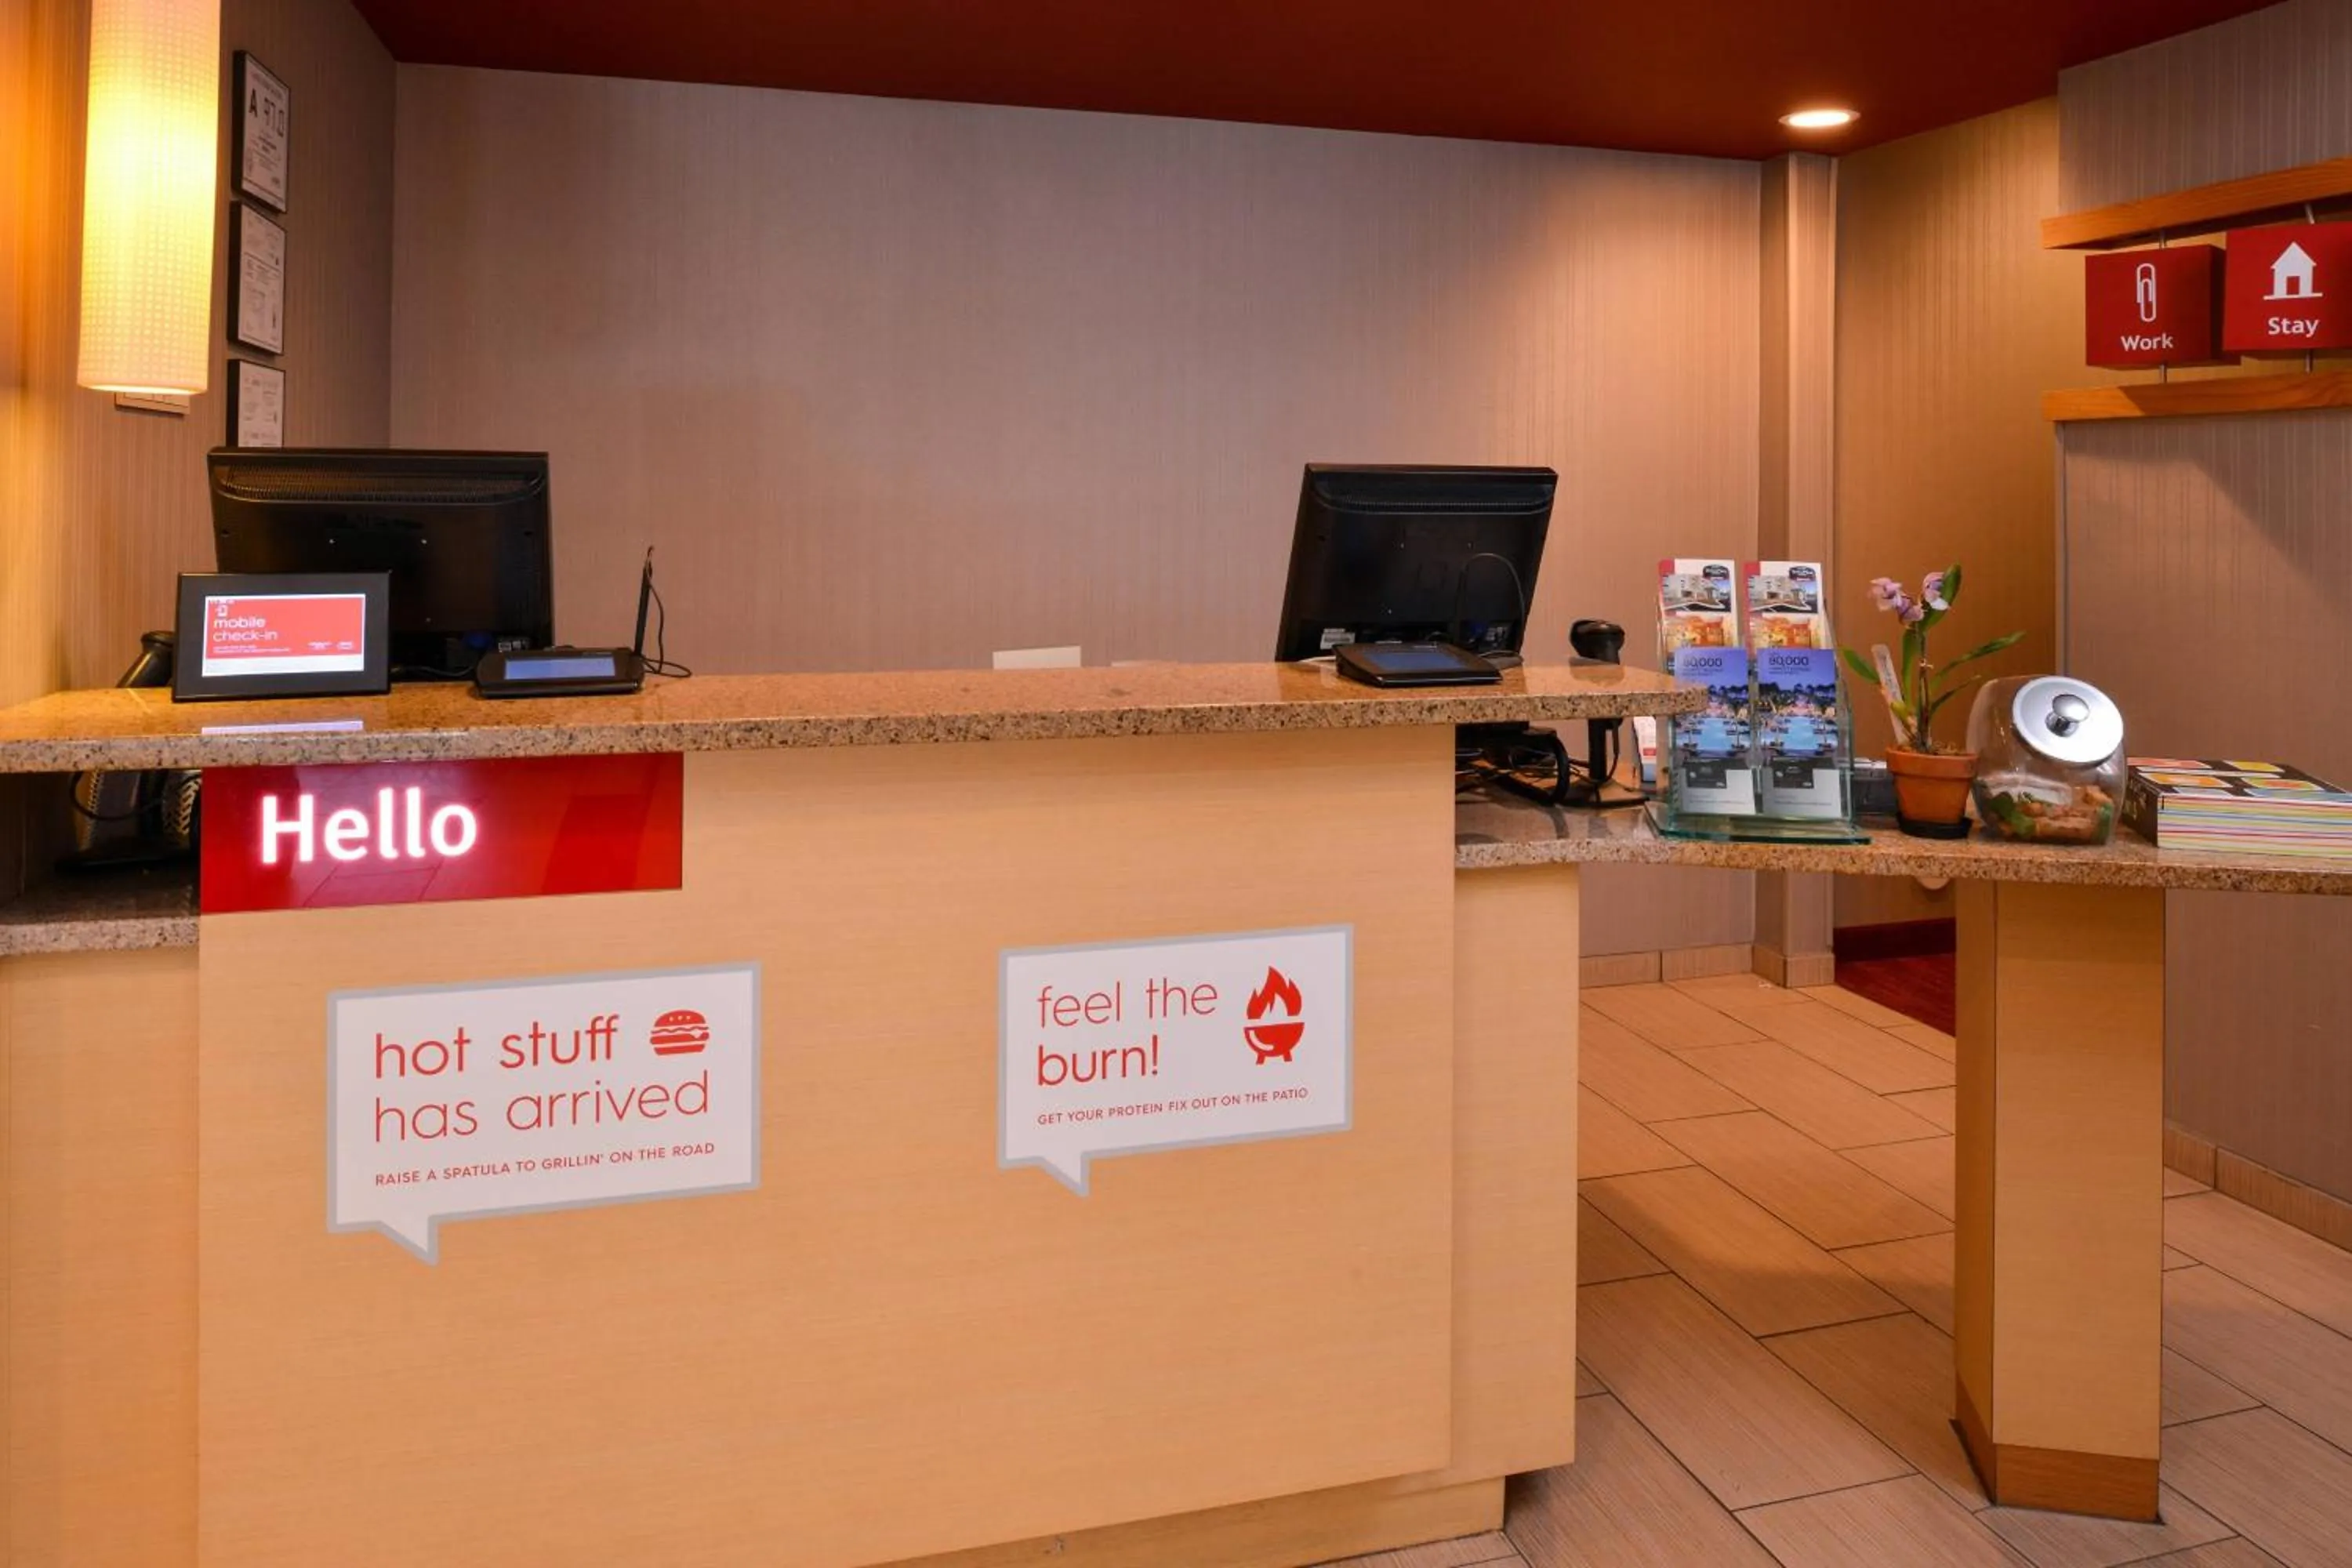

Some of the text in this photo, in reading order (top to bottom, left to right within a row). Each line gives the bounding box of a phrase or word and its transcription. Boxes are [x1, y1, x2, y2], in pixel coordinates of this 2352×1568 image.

[2120, 332, 2174, 351] Work
[2267, 317, 2319, 338] Stay
[212, 630, 278, 643] check-in
[213, 616, 267, 629] mobile
[262, 786, 477, 864] Hello
[1036, 977, 1218, 1029] feel the
[374, 1013, 620, 1080] hot stuff
[1036, 1033, 1159, 1087] burn!
[374, 1069, 709, 1143] has arrived
[1037, 1087, 1309, 1126] GET YOUR PROTEIN FIX OUT ON THE PATIO
[375, 1142, 715, 1187] RAISE A SPATULA TO GRILLIN' ON THE ROAD
